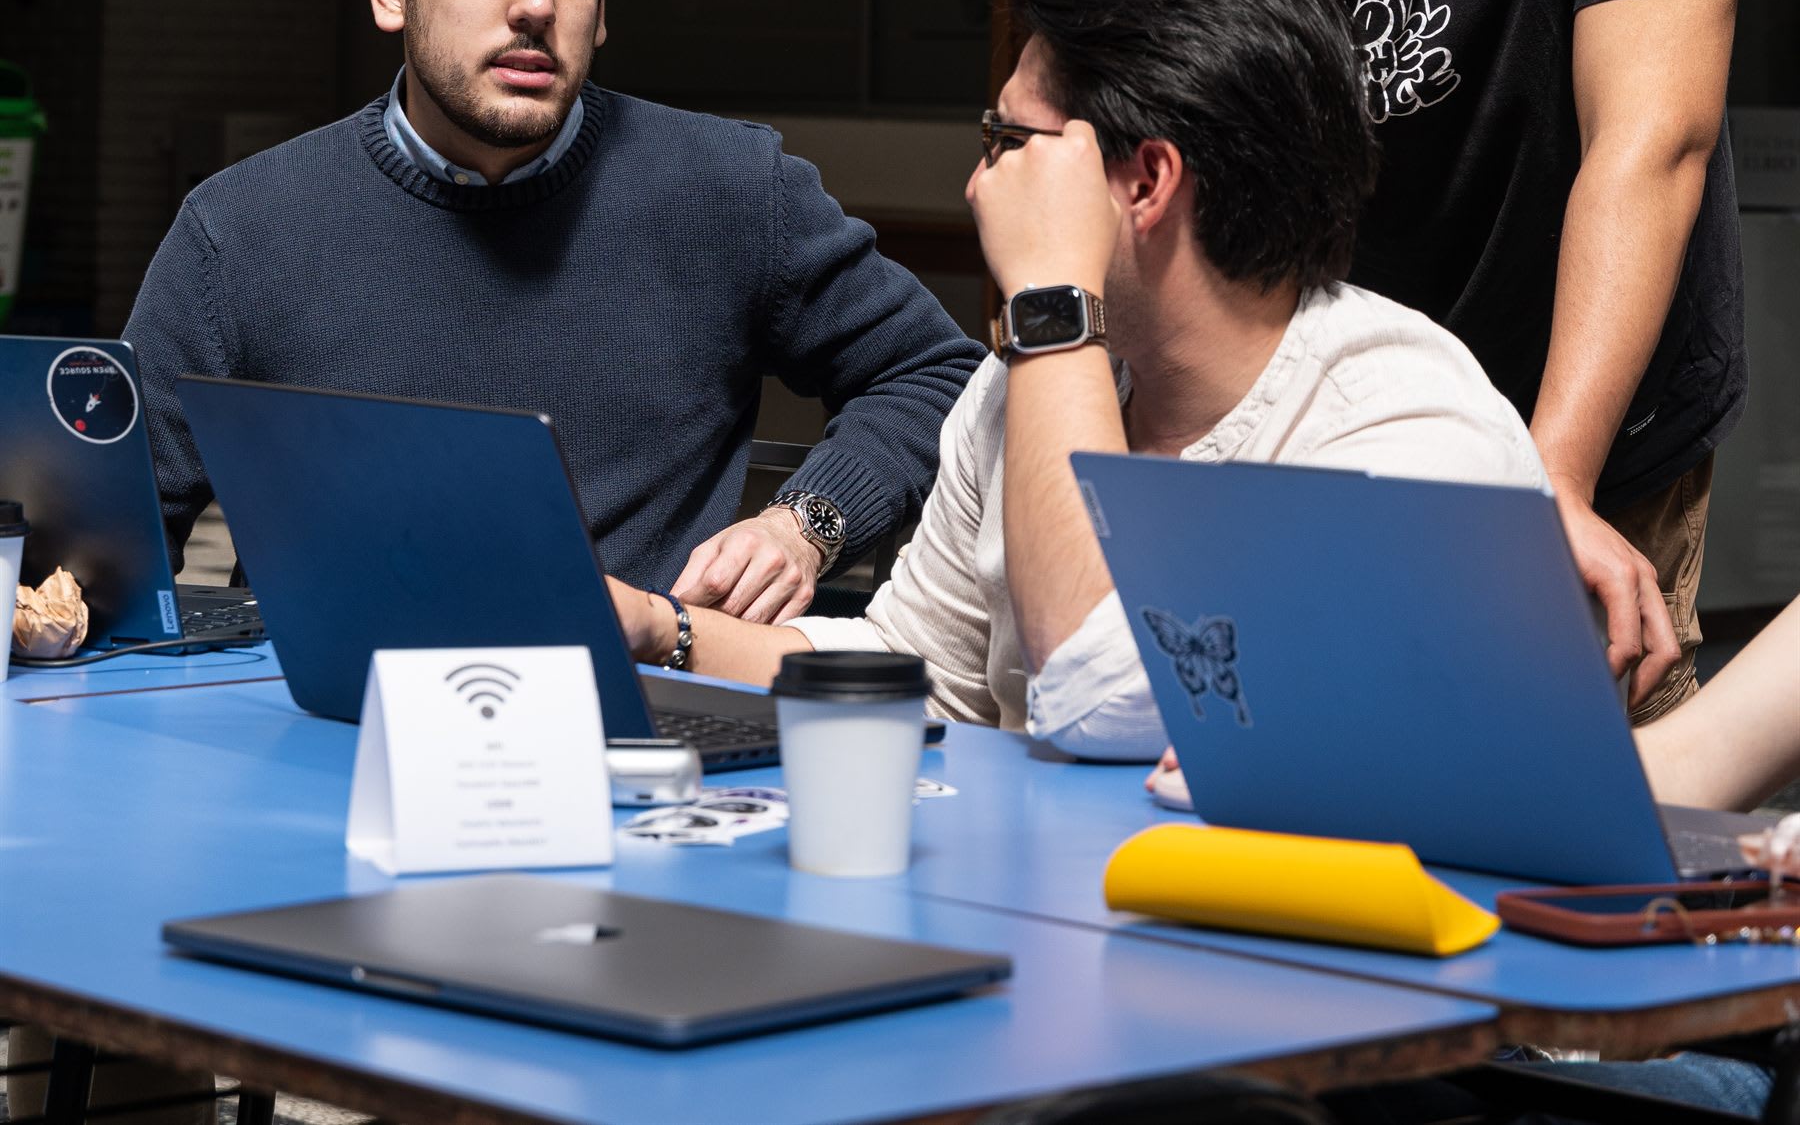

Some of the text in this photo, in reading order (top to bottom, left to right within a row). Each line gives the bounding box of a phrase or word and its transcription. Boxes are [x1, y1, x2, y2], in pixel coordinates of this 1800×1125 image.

[60, 365, 117, 375] OPEN SOURCE
[163, 594, 175, 630] Lenovo
